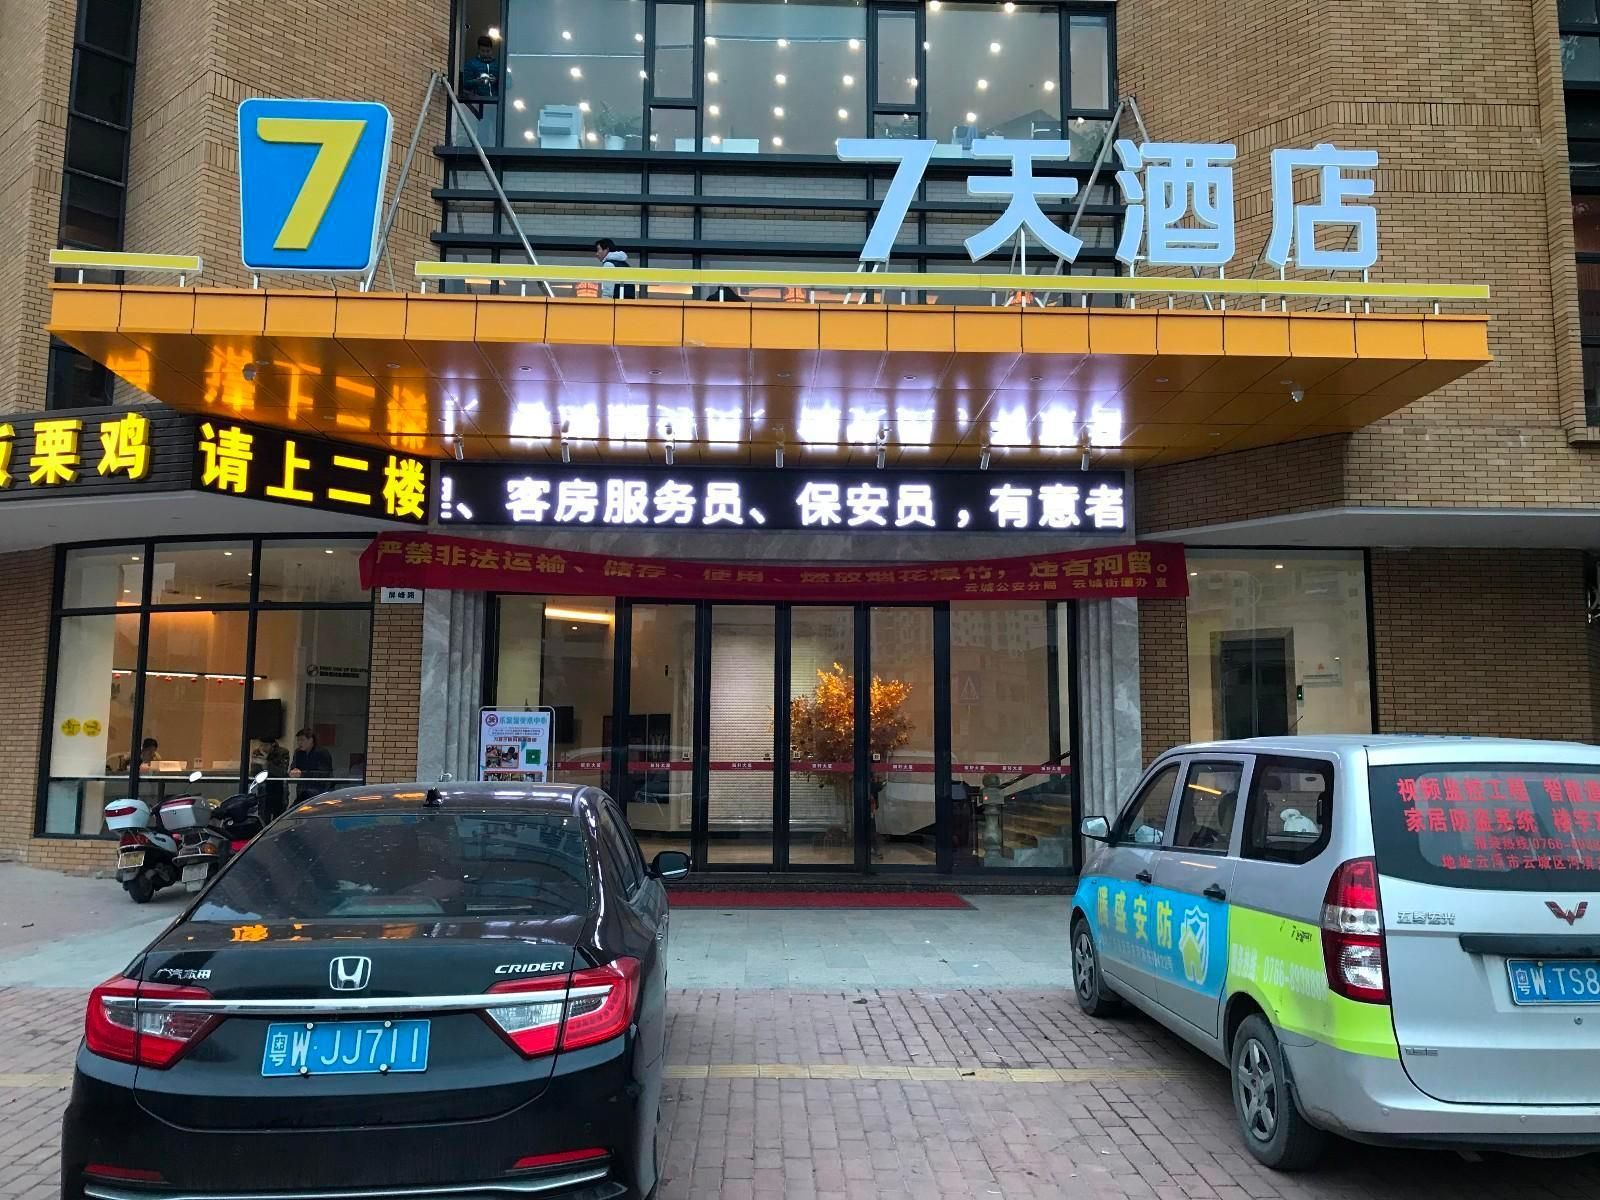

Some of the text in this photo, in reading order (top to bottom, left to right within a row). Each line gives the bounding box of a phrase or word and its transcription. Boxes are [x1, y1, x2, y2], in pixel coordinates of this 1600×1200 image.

[257, 117, 368, 249] 7
[836, 138, 1379, 268] 7天酒店
[199, 422, 427, 519] 请上二楼
[1397, 777, 1529, 802] 视频监控工程
[1404, 807, 1538, 832] 家居防盗系统
[154, 967, 212, 980] 广汽本田
[494, 961, 565, 975] CRIDER
